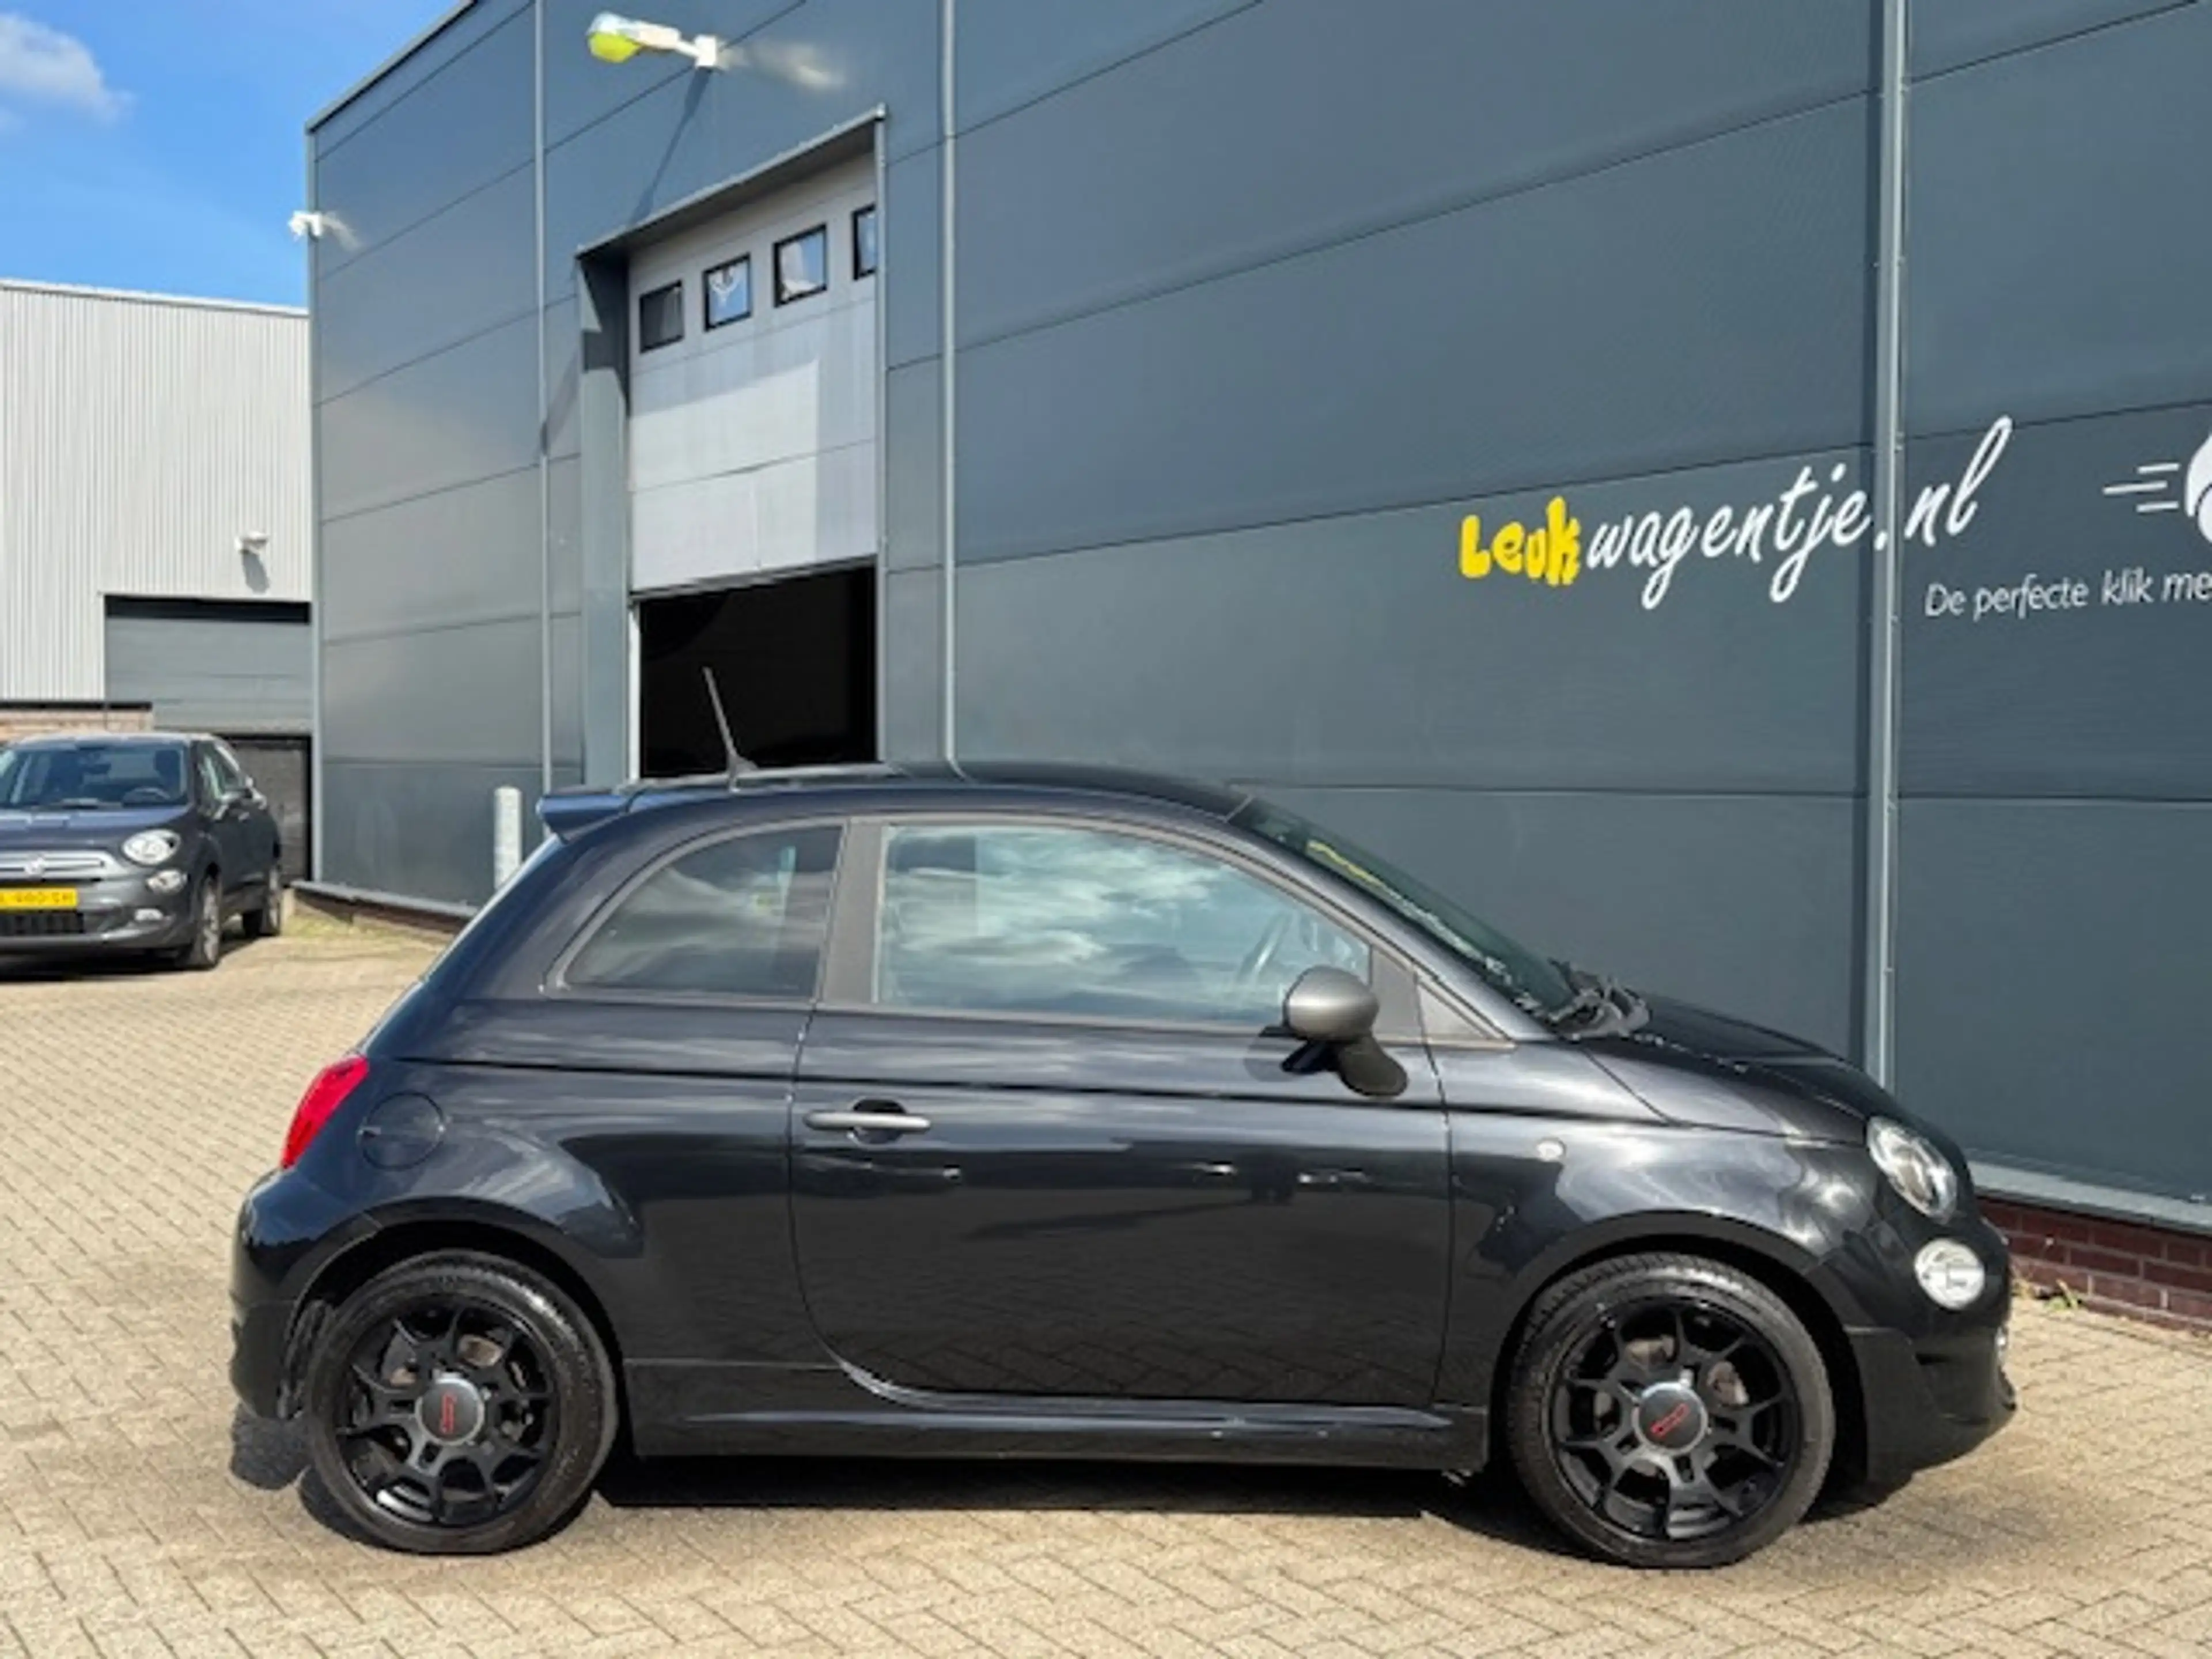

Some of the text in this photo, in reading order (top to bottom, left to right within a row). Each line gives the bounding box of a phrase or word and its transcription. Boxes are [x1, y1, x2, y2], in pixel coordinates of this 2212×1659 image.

[1925, 582, 1967, 616] De
[1973, 574, 2089, 622] perfecte
[2101, 567, 2154, 606] klik
